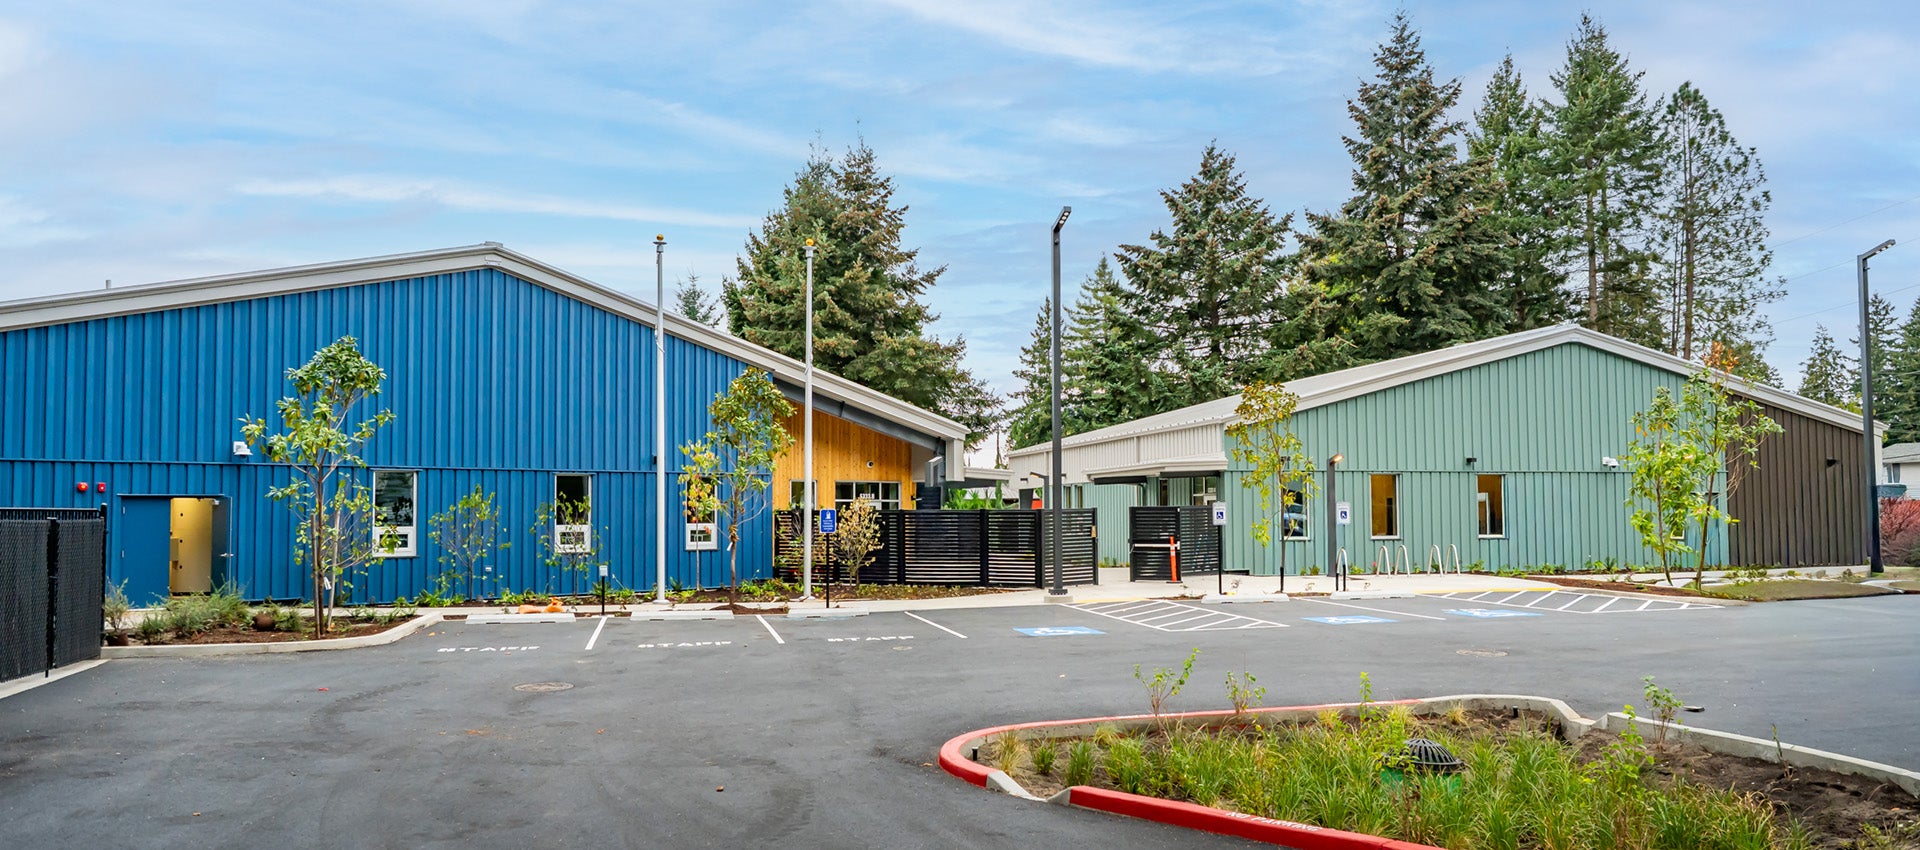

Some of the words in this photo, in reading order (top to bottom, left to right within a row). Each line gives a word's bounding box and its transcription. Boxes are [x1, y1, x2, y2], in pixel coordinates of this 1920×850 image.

[437, 645, 541, 653] STAFF
[638, 641, 732, 649] STAFF
[1226, 811, 1252, 819] NO
[1251, 816, 1323, 832] PARKING
